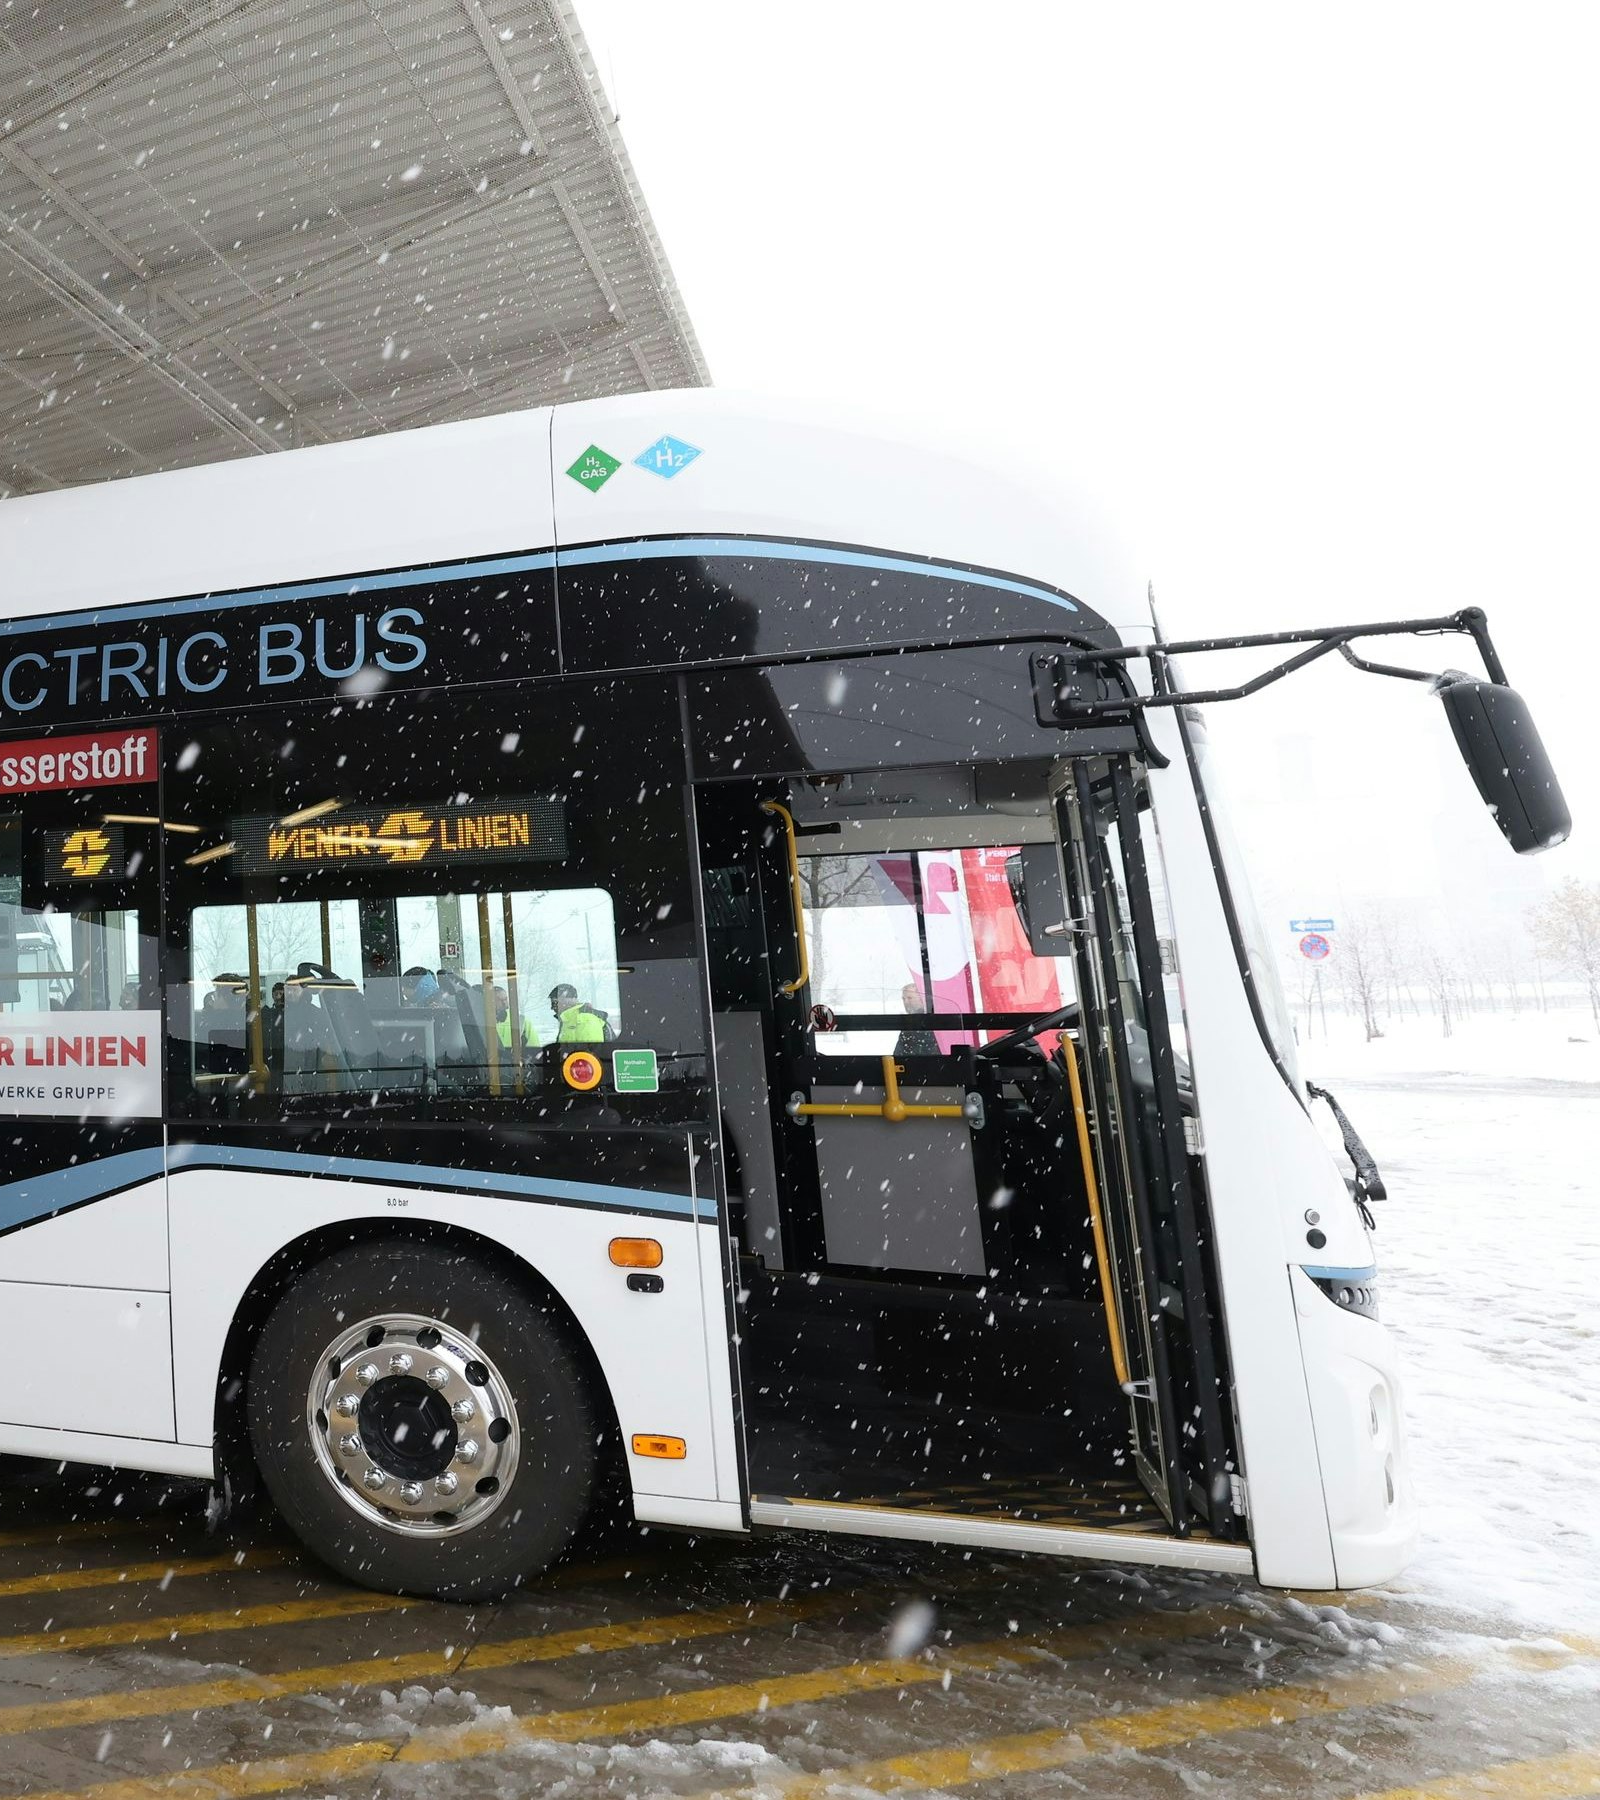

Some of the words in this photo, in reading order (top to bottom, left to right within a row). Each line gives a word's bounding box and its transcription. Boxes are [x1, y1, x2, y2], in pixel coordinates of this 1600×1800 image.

[580, 467, 608, 480] GAS
[258, 606, 429, 687] BUS
[268, 823, 371, 861] WIENER
[439, 813, 530, 851] LINIEN
[24, 1036, 147, 1067] LINIEN
[52, 1086, 117, 1100] GRUPPE
